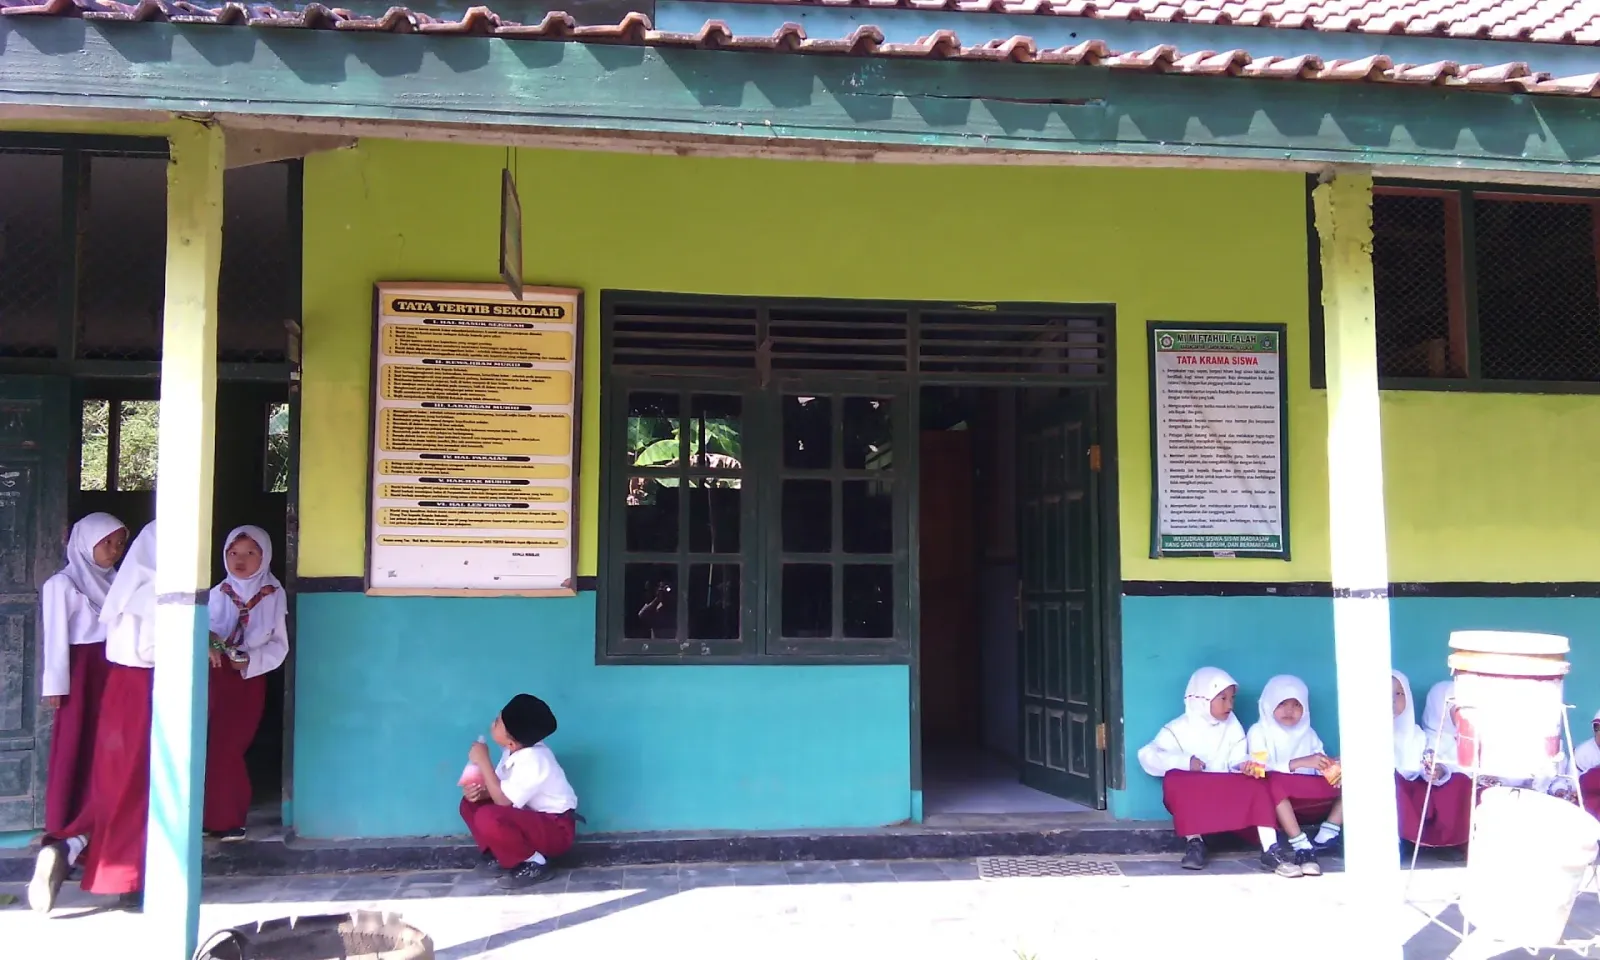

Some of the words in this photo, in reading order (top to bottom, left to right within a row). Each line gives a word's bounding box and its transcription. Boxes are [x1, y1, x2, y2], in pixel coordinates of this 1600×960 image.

[397, 301, 434, 311] TATA
[437, 303, 490, 314] TERTIB
[493, 306, 559, 317] SEKOLAH
[1188, 334, 1229, 343] MIFTAHUL
[1231, 335, 1257, 344] FALAH
[1176, 355, 1197, 365] TATA
[1199, 356, 1230, 365] KRAMA
[1232, 356, 1259, 366] SISWA
